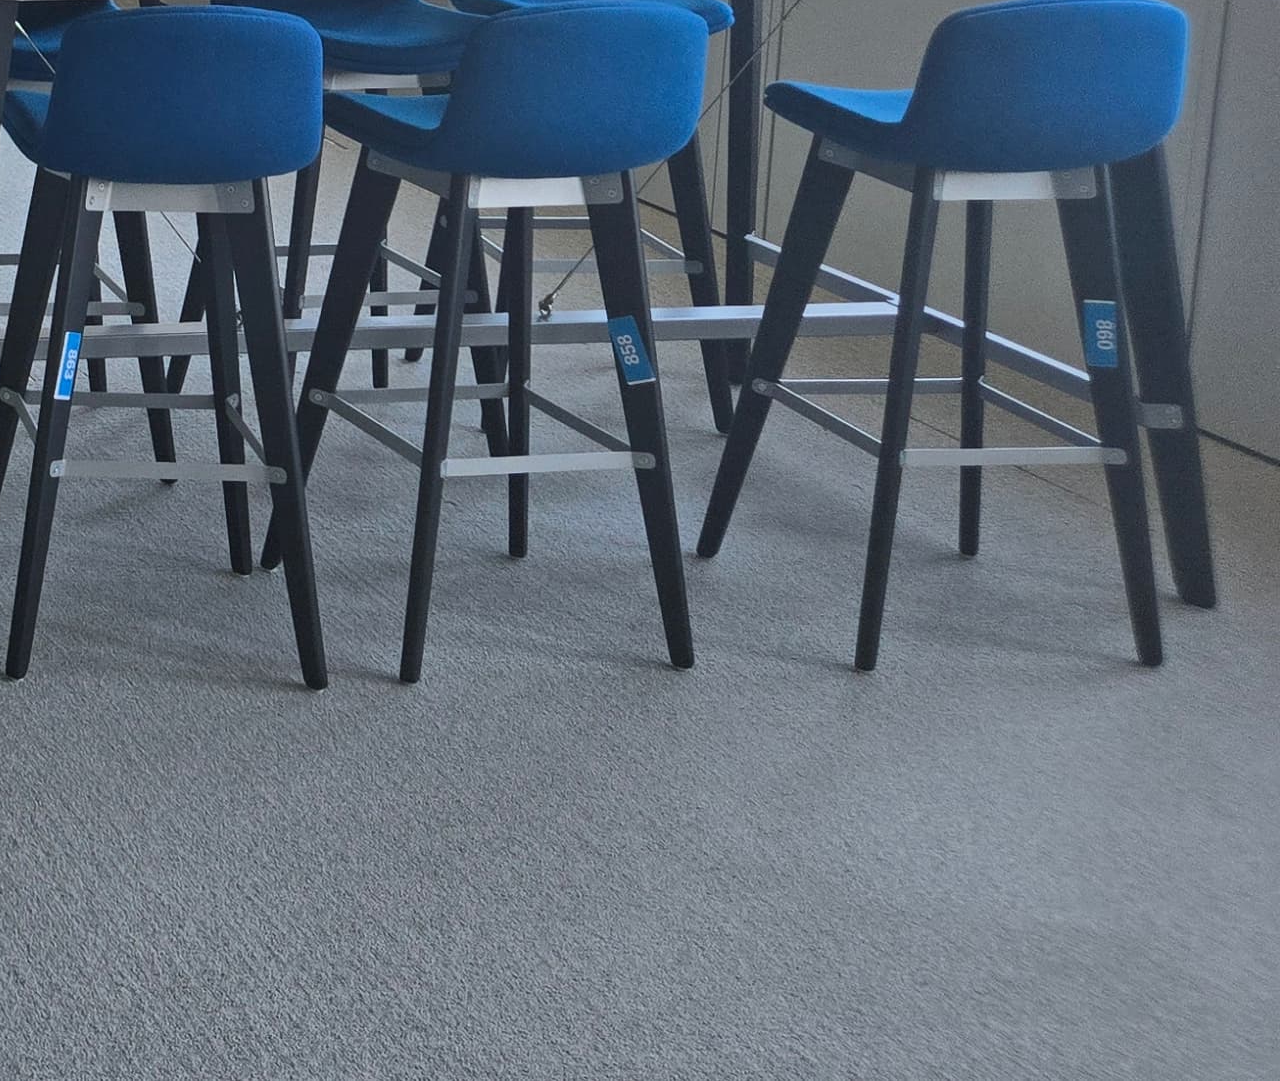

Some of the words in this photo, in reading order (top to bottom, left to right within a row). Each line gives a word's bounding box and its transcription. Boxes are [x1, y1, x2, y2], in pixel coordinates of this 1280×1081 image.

[616, 333, 640, 366] 858
[1095, 319, 1114, 351] 860
[63, 348, 79, 381] 863
